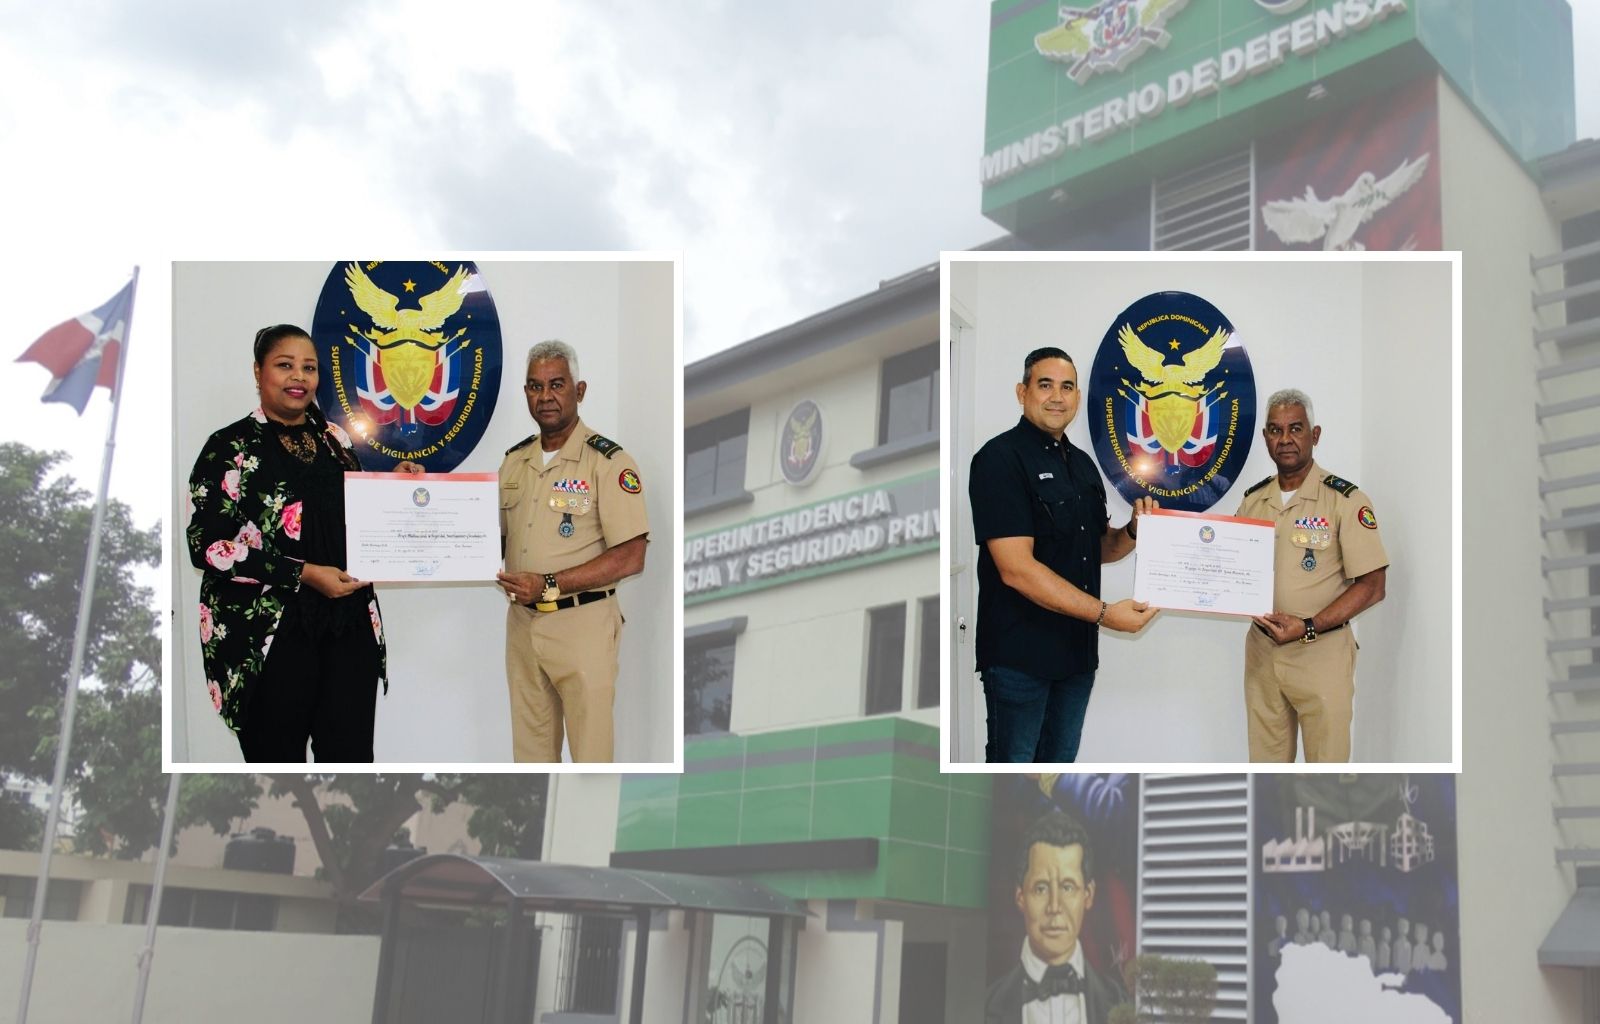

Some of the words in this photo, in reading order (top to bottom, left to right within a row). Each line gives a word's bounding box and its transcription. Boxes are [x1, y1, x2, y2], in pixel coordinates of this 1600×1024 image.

[980, 83, 1164, 184] MINISTERIO
[1167, 57, 1219, 107] DE
[1137, 314, 1170, 333] REPUBLICA
[1170, 314, 1210, 335] DOMINICANA
[368, 438, 381, 450] DE
[381, 445, 439, 460] VIGILANCIA
[438, 438, 445, 449] Y
[445, 390, 478, 443] SEGURIDAD
[472, 347, 483, 391] PRIVADA
[1135, 476, 1147, 488] DE
[1147, 484, 1198, 497] VIGILANCIA
[1198, 477, 1205, 487] Y
[1204, 435, 1234, 482] SEGURIDAD
[1229, 398, 1239, 435] PRIVADA
[727, 558, 741, 583] Y
[747, 523, 885, 579] SEGURIDAD
